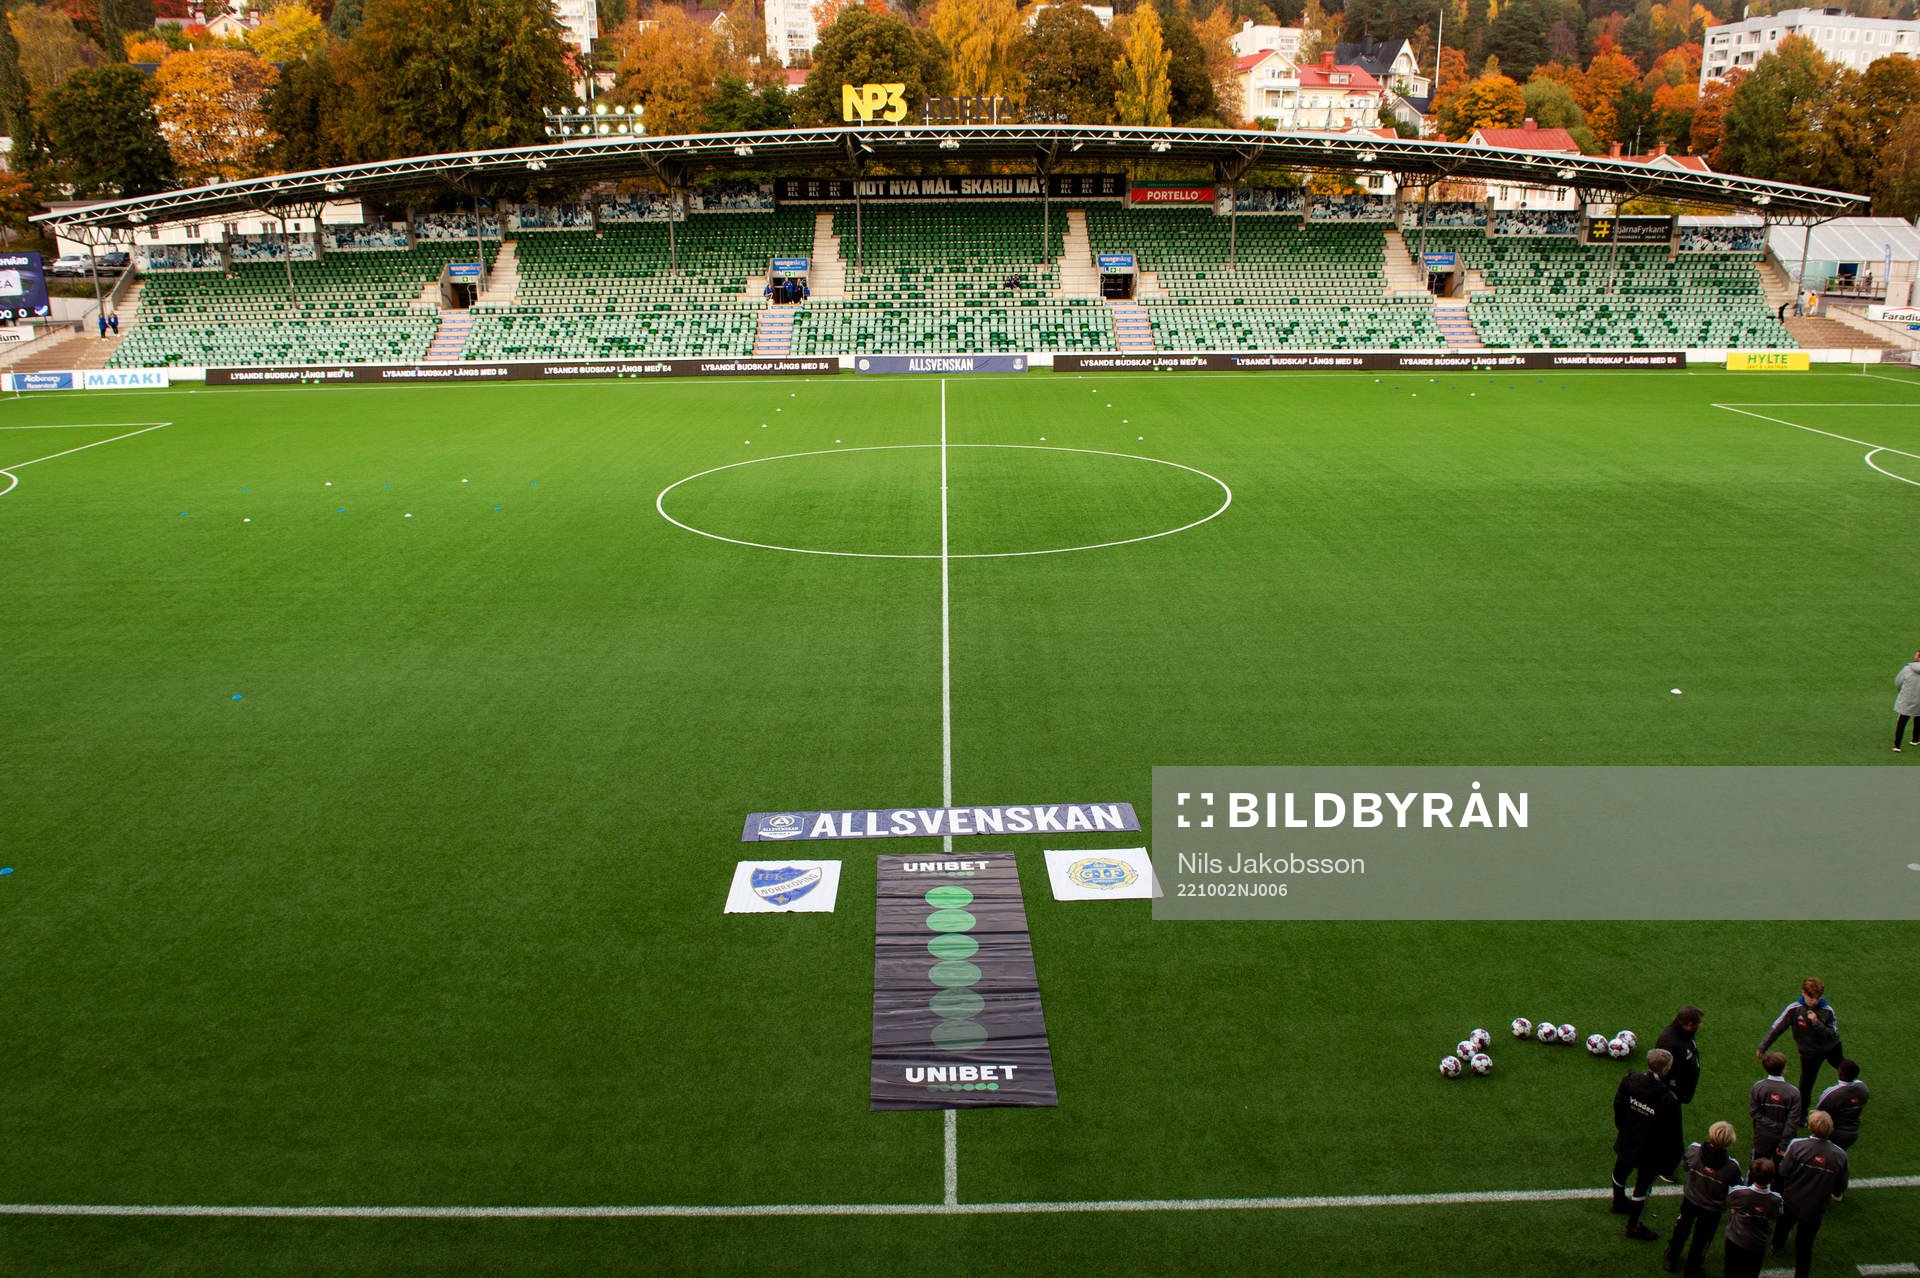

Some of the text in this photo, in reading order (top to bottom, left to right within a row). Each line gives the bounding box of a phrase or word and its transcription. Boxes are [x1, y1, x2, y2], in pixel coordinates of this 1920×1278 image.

[842, 83, 908, 122] NP3
[920, 95, 1016, 121] ARENA
[853, 180, 887, 195] MOT
[889, 180, 919, 195] NYA
[921, 177, 958, 194] MÅL.
[961, 178, 1013, 194] SKARU
[1146, 190, 1200, 200] PORTELLO
[1081, 359, 1114, 367] LYSANDE
[1180, 358, 1196, 366] MED
[1237, 358, 1270, 366] LYSANDE
[1400, 358, 1433, 366] LYSANDE
[1435, 358, 1470, 366] BUDSKAP
[1499, 357, 1515, 365] MED
[1650, 356, 1666, 364] MED
[1748, 354, 1788, 364] HYLTE
[579, 366, 615, 374] BUDSKAP
[644, 365, 662, 373] MED
[736, 363, 773, 371] BUDSKAP
[801, 362, 817, 370] MED
[908, 358, 974, 371] ALLSVENSKAN
[231, 372, 263, 380] LYSANDE
[383, 370, 417, 378] LYSANDE
[418, 369, 452, 377] BUDSKAP
[480, 368, 497, 376] MED
[88, 373, 161, 386] MATAKI
[809, 805, 1125, 838] ALLSVENSKAN
[903, 861, 990, 872] UNIBET
[905, 1065, 1018, 1083] UNIBET
